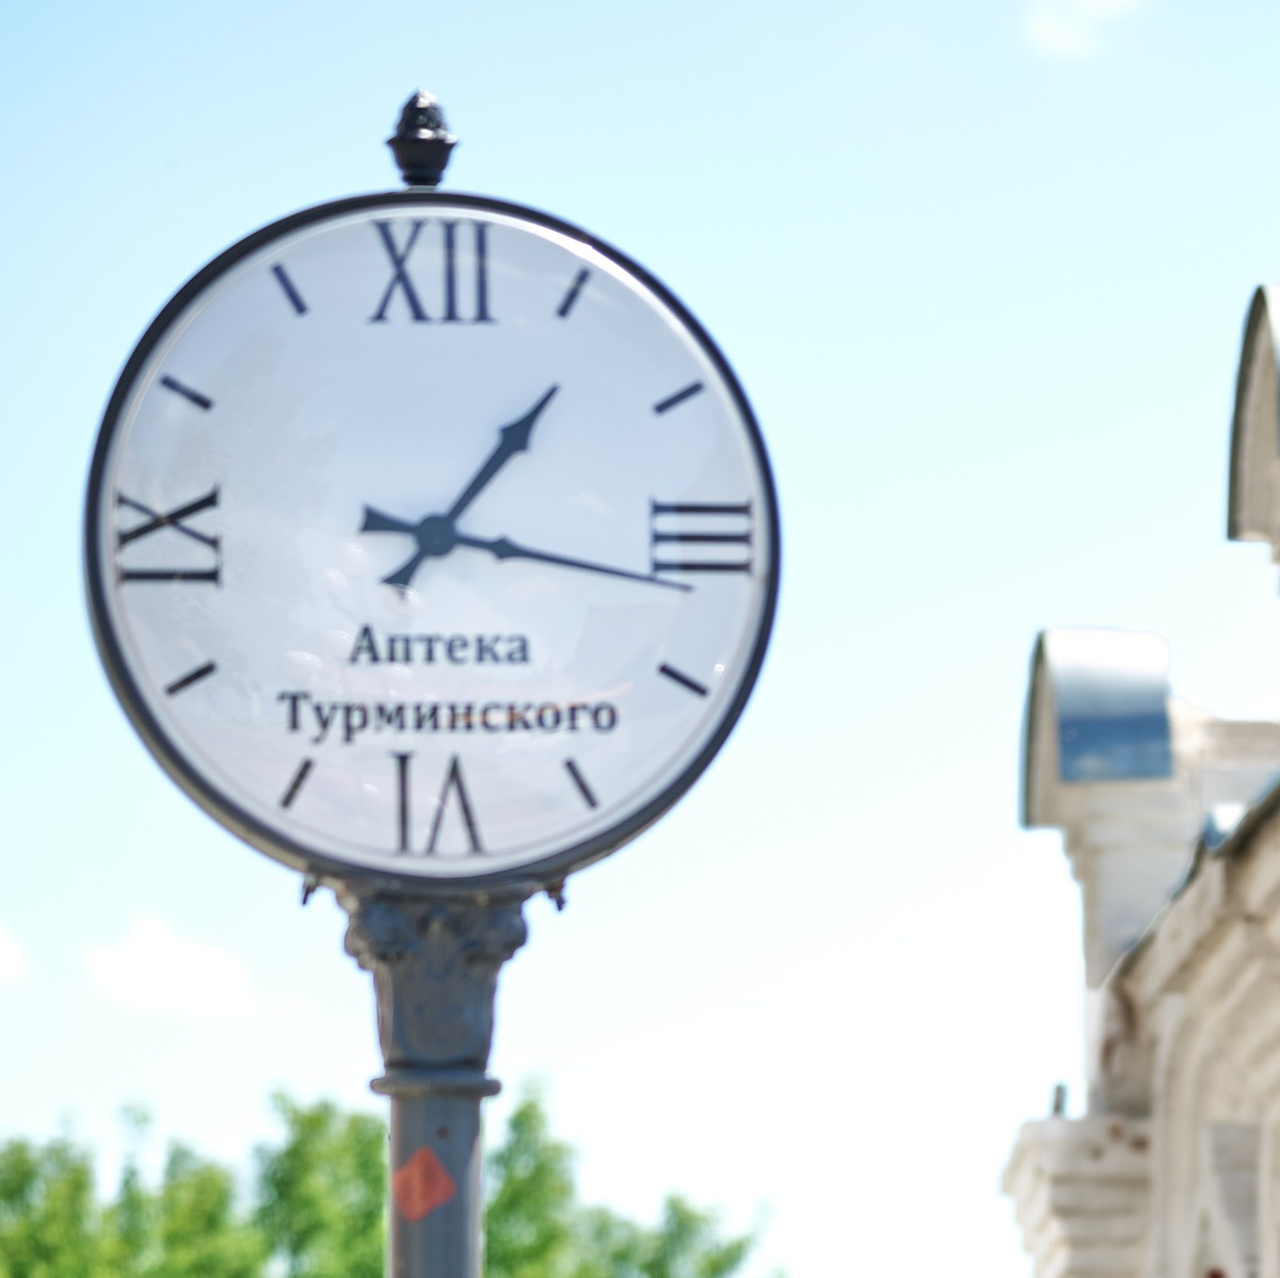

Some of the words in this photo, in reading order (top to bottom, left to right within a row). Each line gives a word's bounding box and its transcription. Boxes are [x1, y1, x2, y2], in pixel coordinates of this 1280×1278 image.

[369, 218, 499, 324] XII
[114, 485, 222, 588] IX
[649, 496, 755, 579] III
[348, 623, 531, 665] Аптека
[277, 690, 619, 745] Турминского
[390, 750, 490, 857] VI
